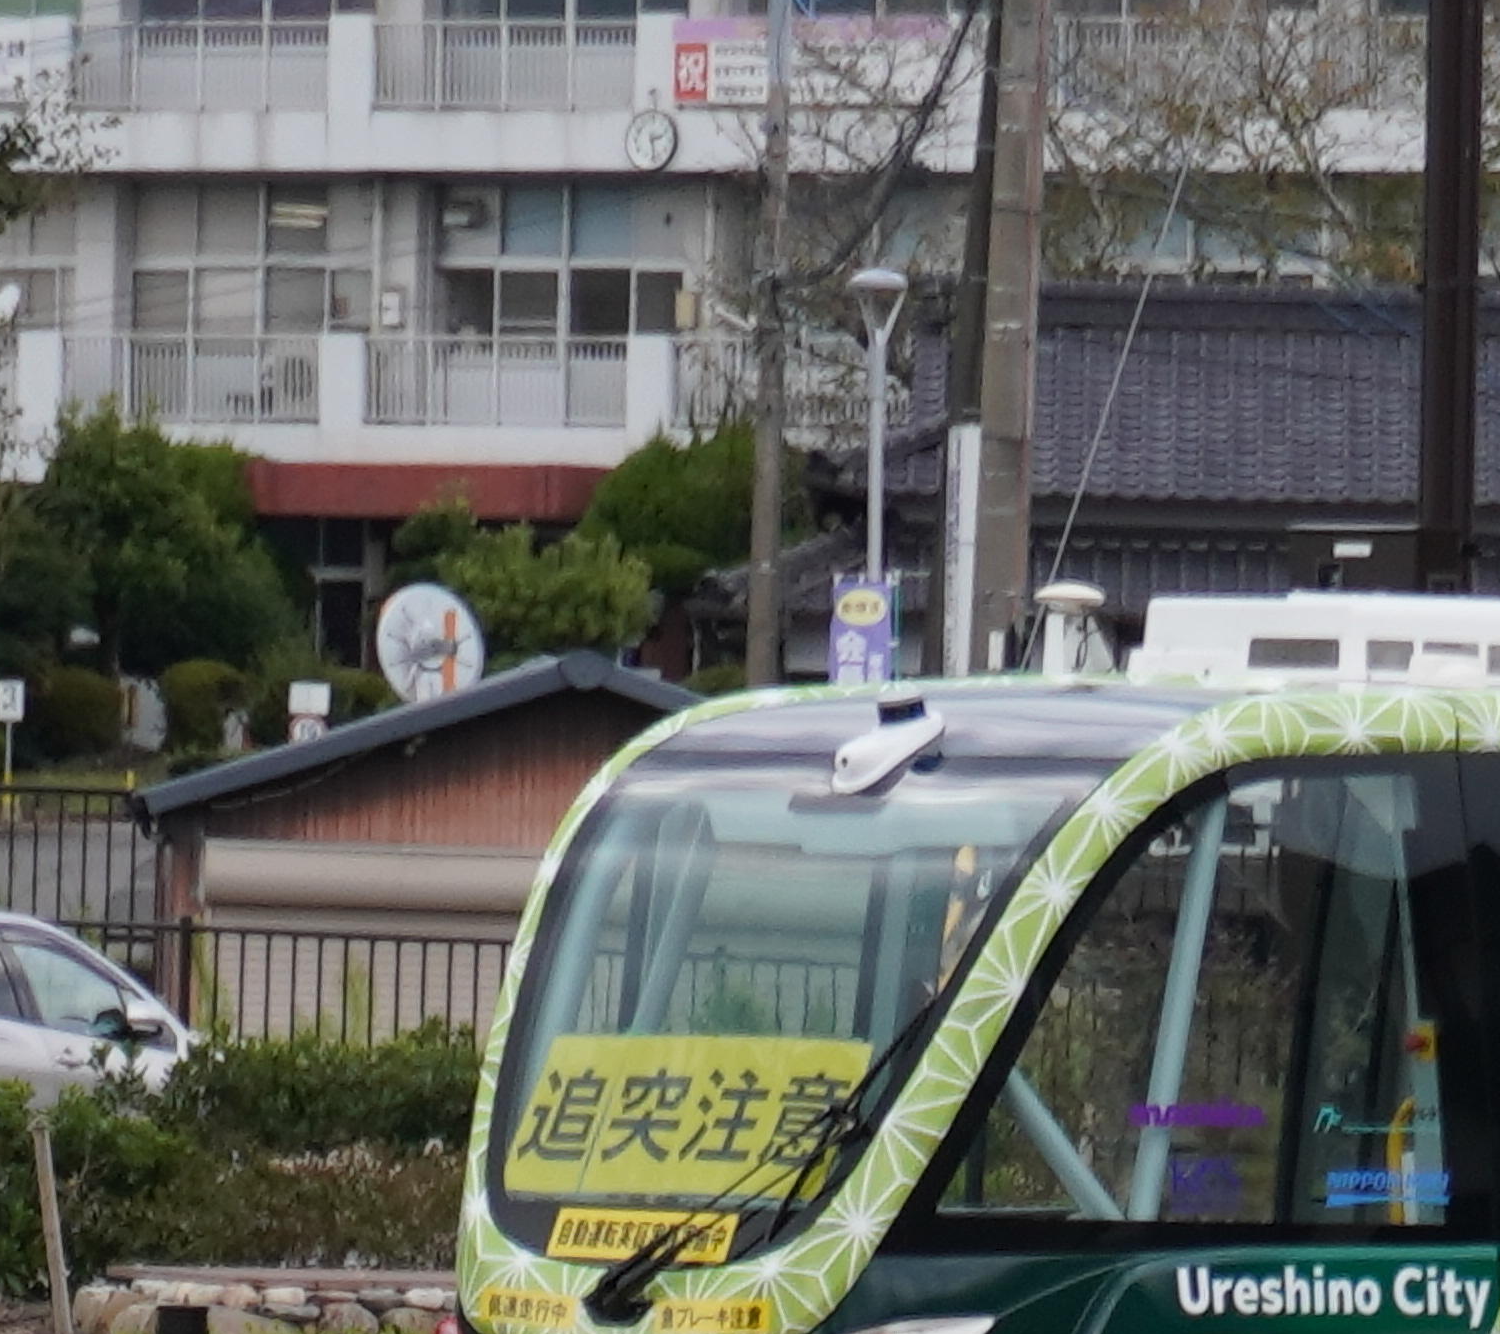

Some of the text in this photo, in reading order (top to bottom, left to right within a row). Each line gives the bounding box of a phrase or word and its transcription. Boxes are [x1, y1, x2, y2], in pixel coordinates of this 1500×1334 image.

[517, 1068, 852, 1169] 追突注意
[1176, 1264, 1492, 1331] Ureshino City
